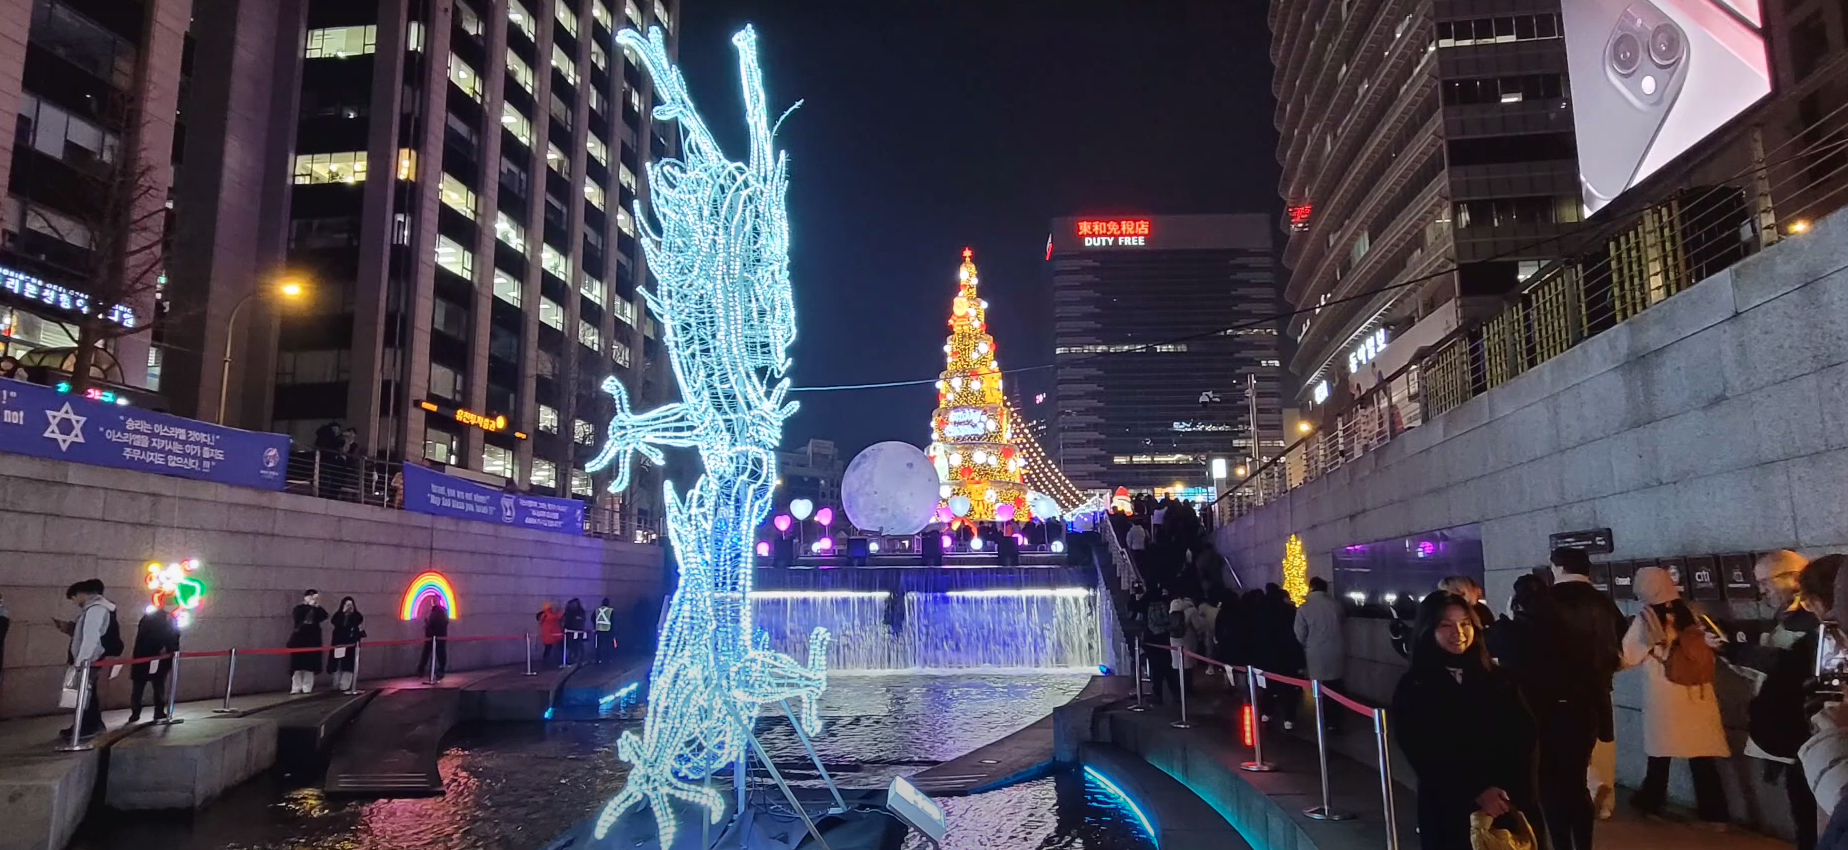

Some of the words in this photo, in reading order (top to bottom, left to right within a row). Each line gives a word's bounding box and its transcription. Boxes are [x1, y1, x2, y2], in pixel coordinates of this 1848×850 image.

[1084, 236, 1114, 246] DUTY
[1118, 236, 1146, 246] FREE
[3, 409, 24, 425] not
